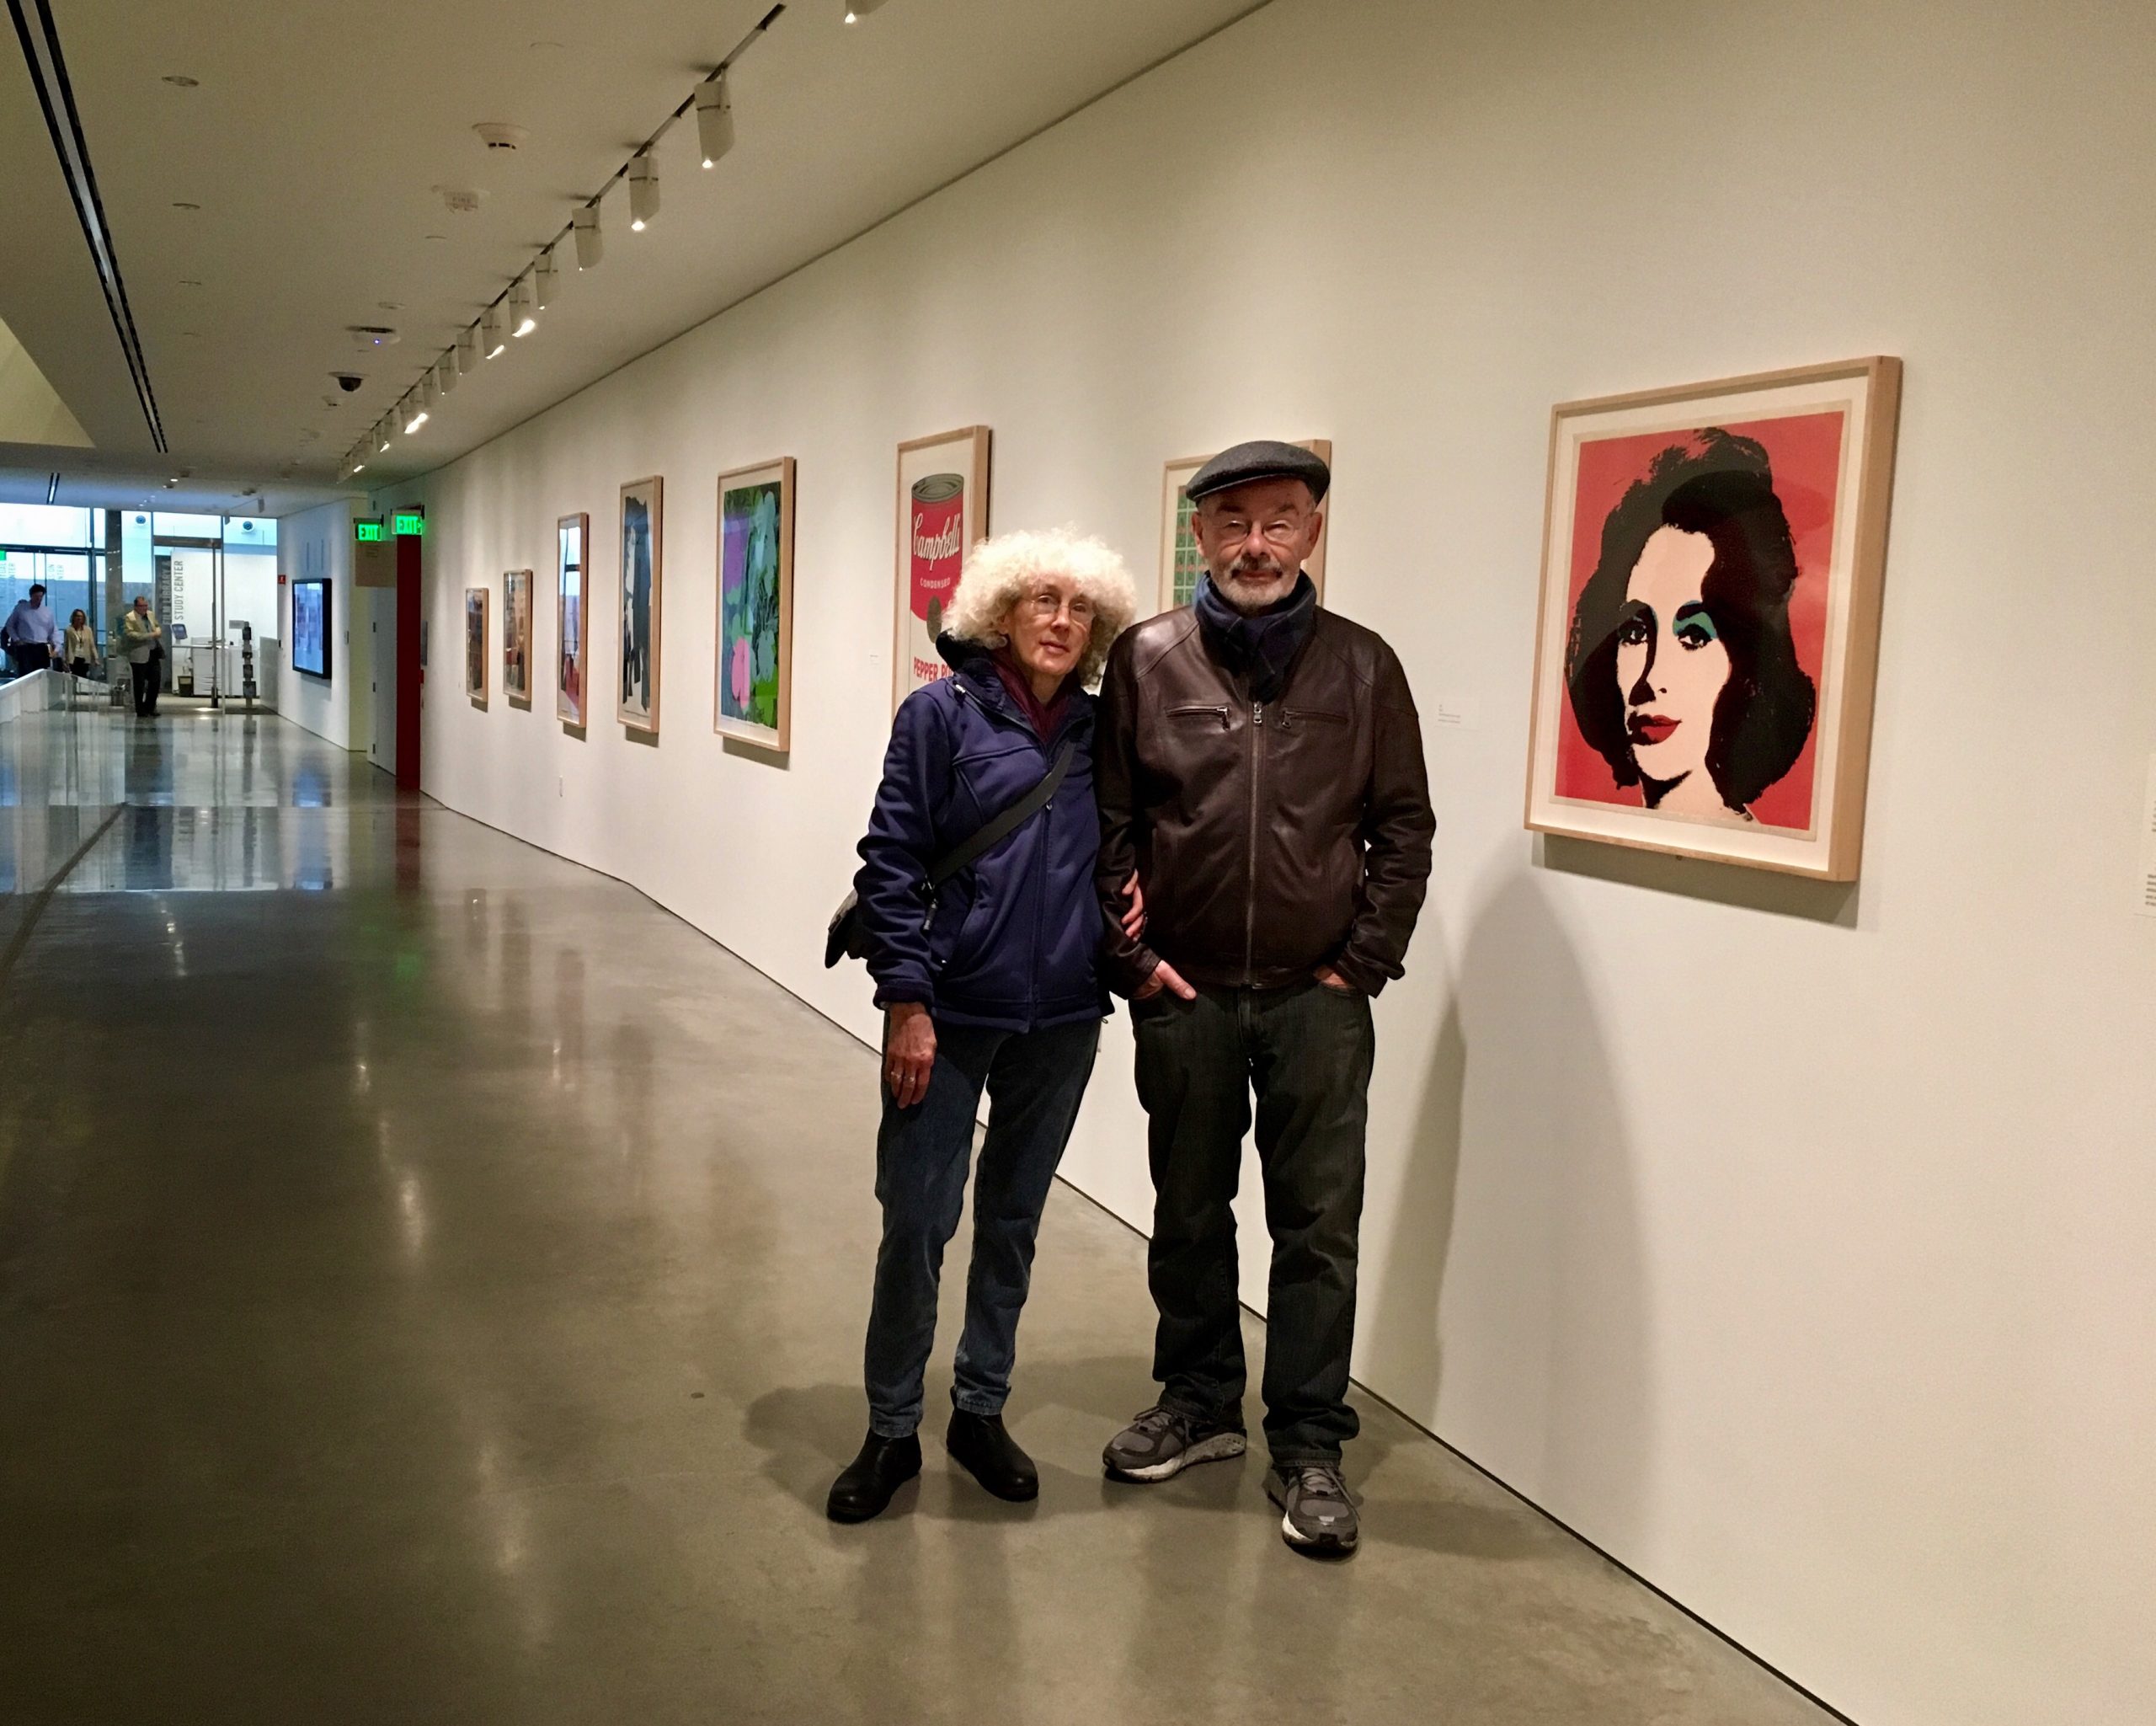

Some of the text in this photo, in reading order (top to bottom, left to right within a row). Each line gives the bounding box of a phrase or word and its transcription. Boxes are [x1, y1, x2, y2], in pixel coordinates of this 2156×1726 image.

[358, 524, 378, 541] EXIT
[396, 516, 419, 534] EXIT
[162, 569, 172, 603] LIBRARY
[173, 560, 184, 620] STUDY CENTER
[920, 577, 951, 590] CONDENSED
[914, 656, 938, 683] PEPPER
